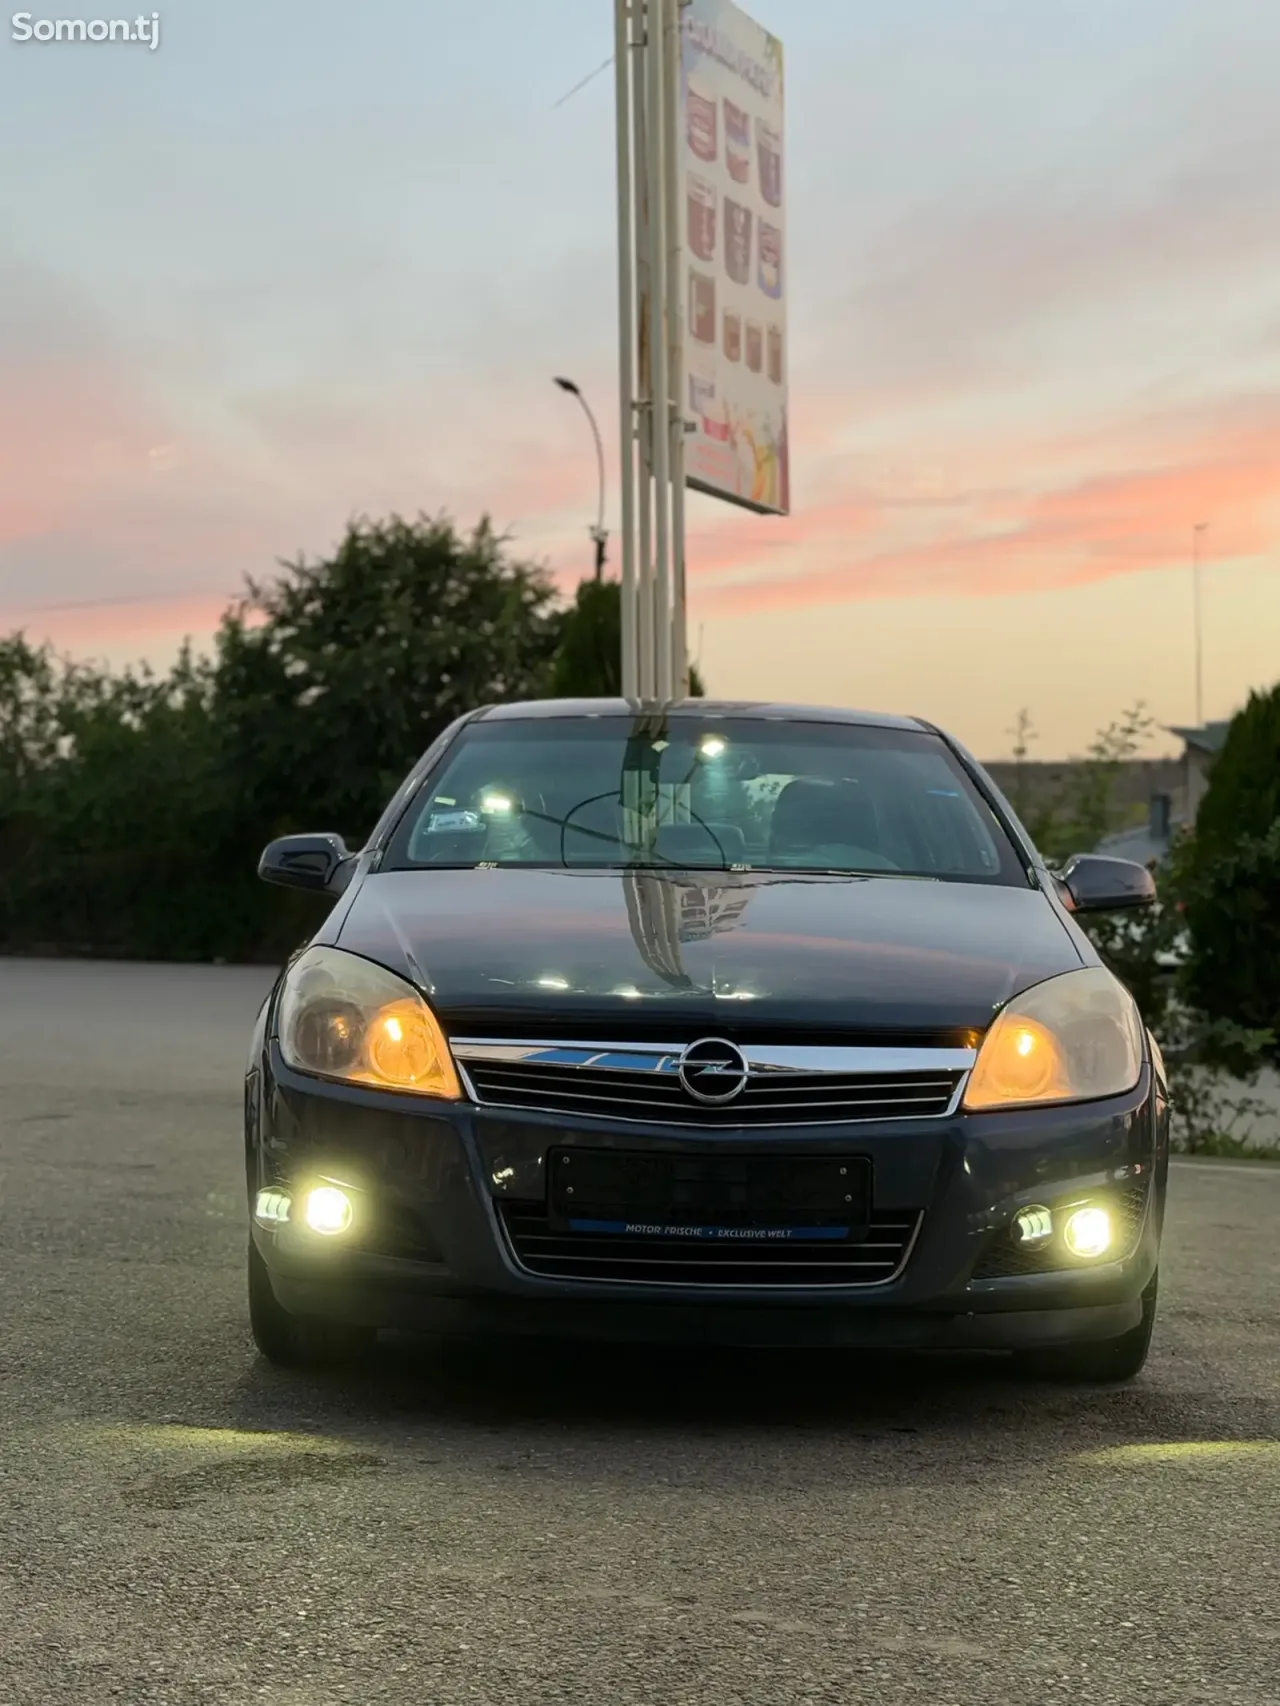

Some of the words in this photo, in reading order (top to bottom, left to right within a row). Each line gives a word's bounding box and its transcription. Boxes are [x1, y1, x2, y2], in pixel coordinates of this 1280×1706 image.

[625, 1223, 661, 1234] MOTOR
[664, 1226, 703, 1236] FRISCHE
[718, 1228, 766, 1239] EXCLUSIVE
[767, 1229, 793, 1239] WELT
